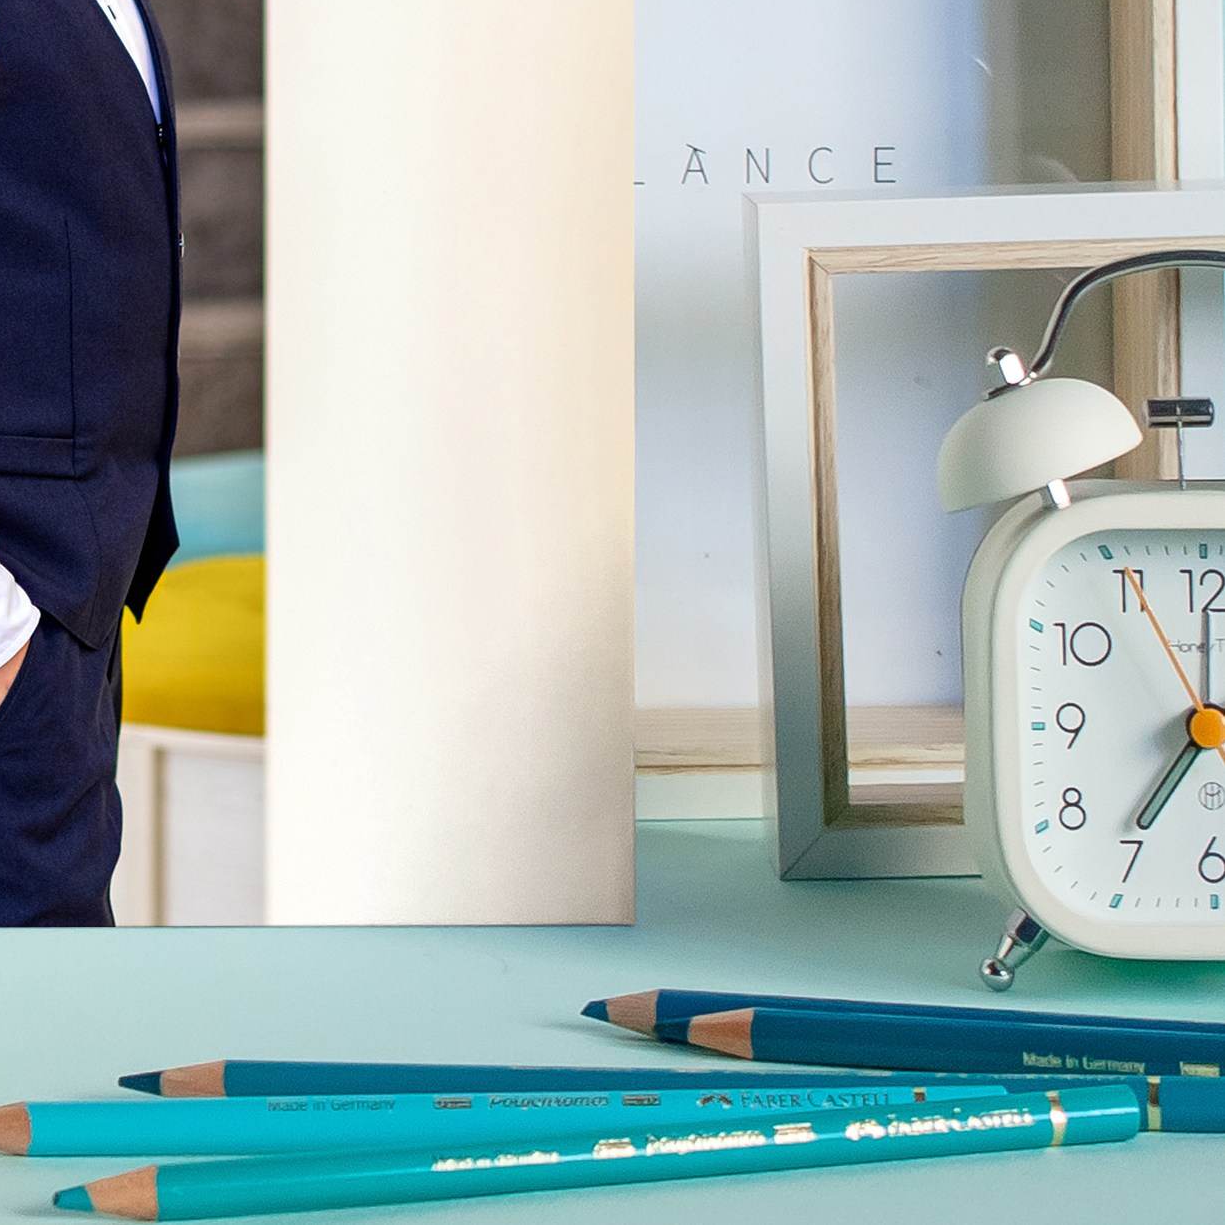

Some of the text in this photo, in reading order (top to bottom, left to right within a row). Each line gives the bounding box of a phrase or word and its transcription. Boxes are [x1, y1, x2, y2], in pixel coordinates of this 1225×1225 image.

[633, 143, 897, 185] ANCE
[1112, 568, 1225, 613] 11 12
[1053, 621, 1112, 667] 10
[1056, 702, 1086, 750] 9
[1058, 786, 1087, 831] 8
[1120, 836, 1225, 883] 7 6
[1022, 1052, 1145, 1075] Made in Germany
[267, 1096, 307, 1112] Made
[312, 1096, 327, 1111] in
[330, 1095, 396, 1113] Germany
